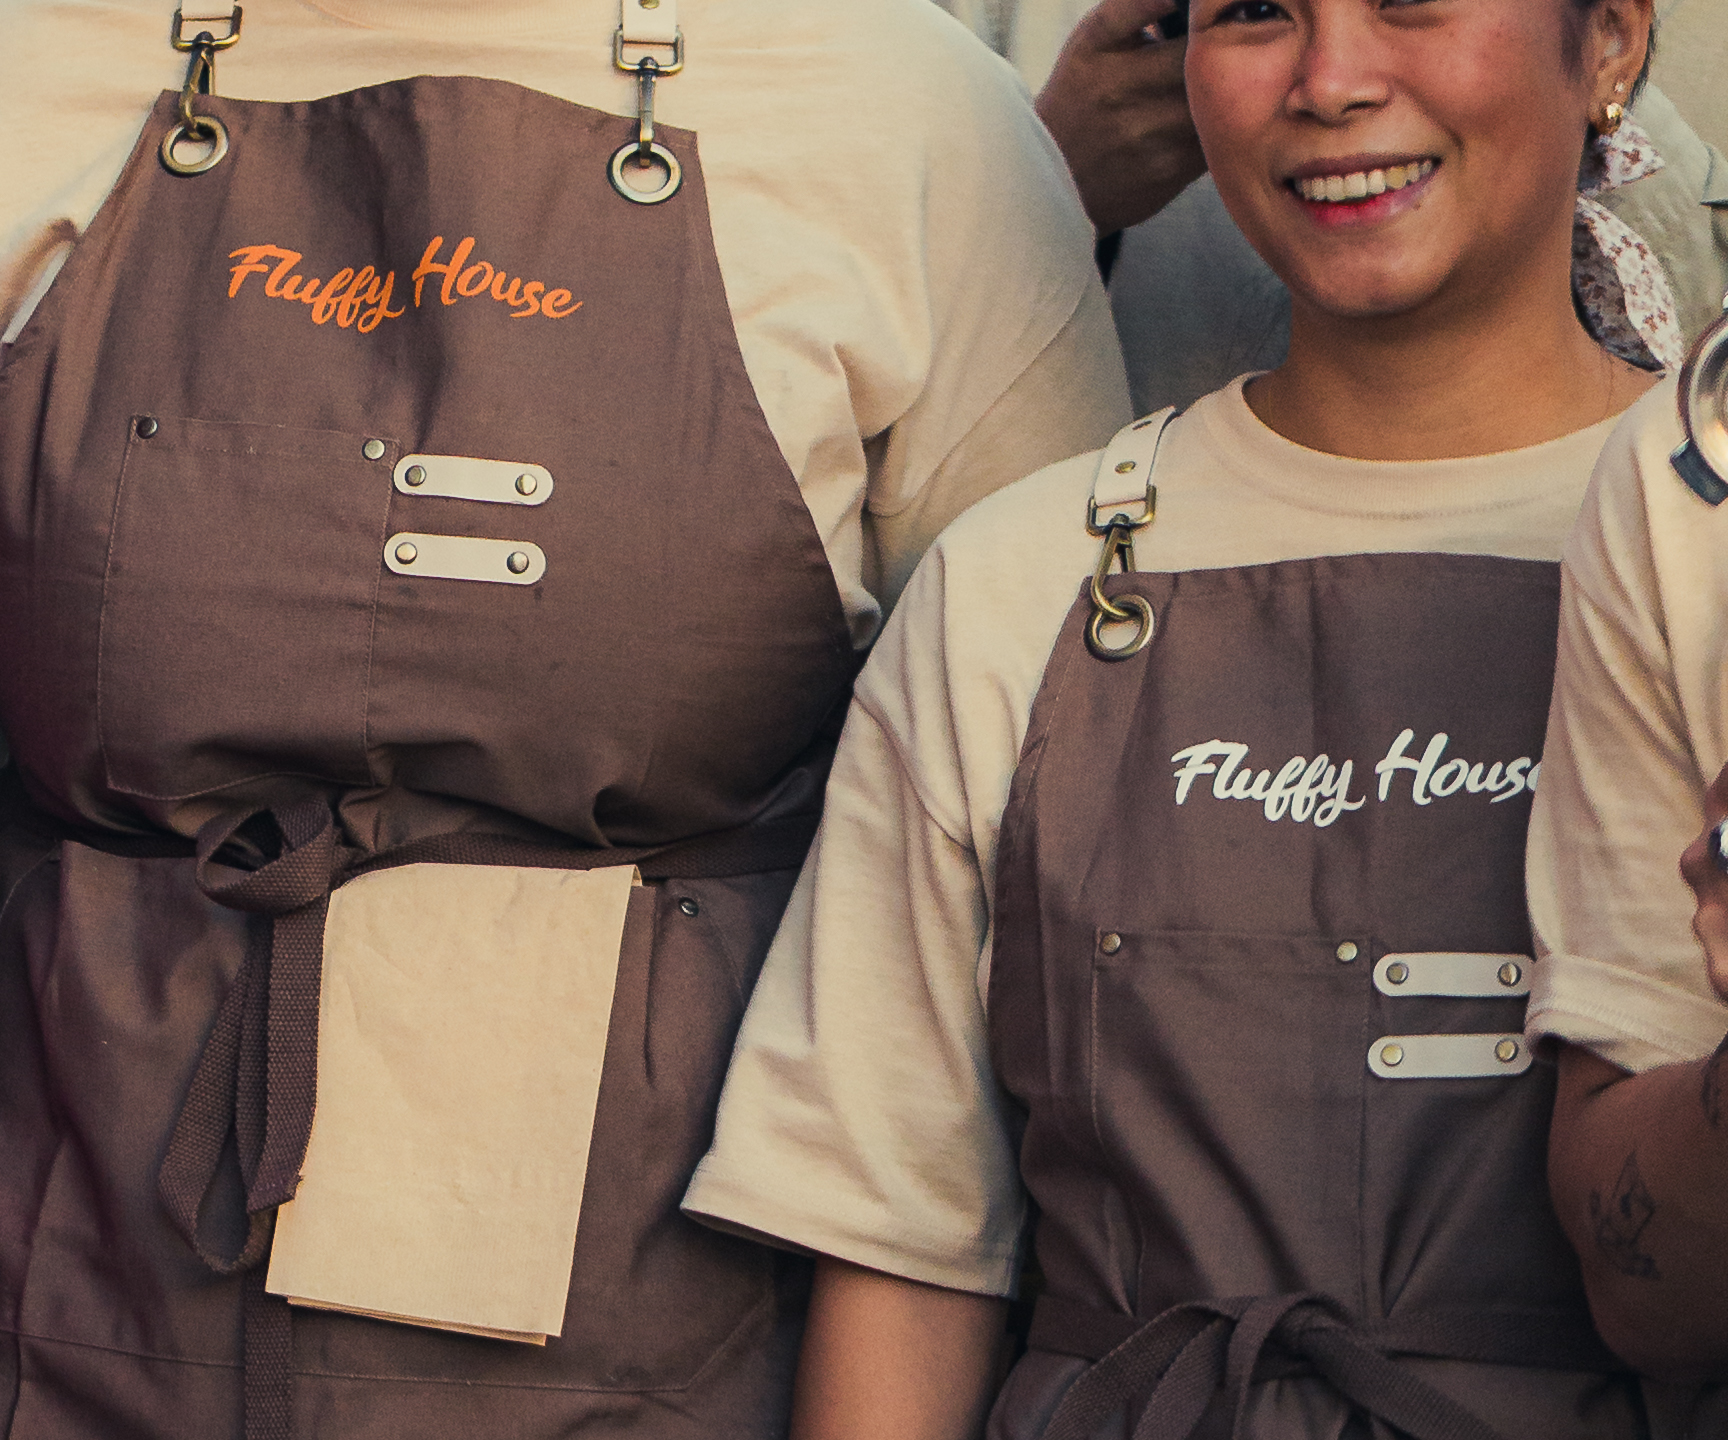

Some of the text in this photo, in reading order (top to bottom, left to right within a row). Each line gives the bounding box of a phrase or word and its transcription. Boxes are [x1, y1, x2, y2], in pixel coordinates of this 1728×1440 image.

[228, 236, 583, 333] Fluffy House
[1171, 739, 1366, 828] Fluffy
